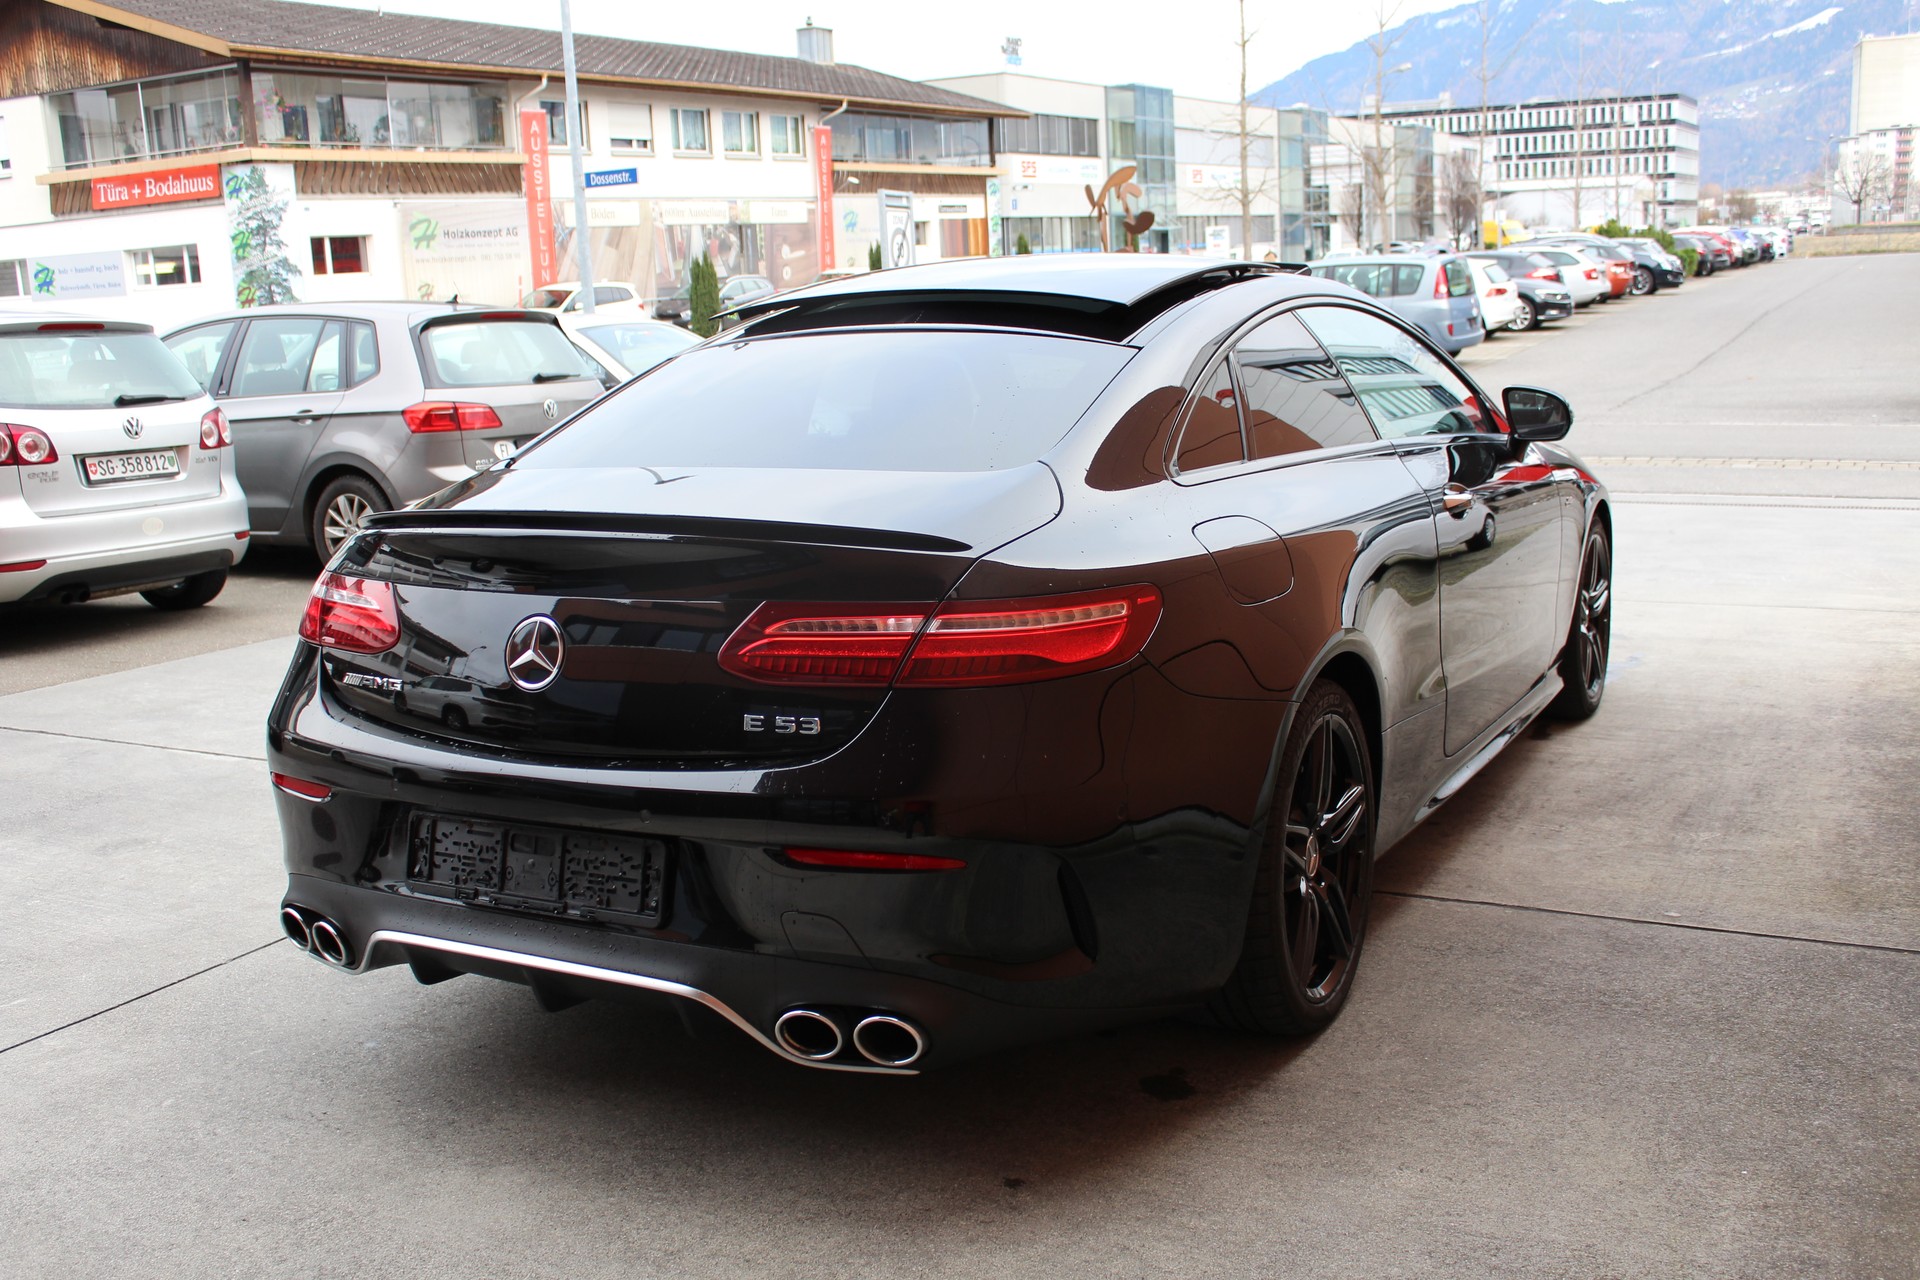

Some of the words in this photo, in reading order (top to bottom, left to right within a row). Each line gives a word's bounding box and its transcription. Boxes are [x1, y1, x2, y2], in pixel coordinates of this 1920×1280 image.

[590, 171, 632, 186] Dossenstr.
[97, 182, 128, 203] Türa
[132, 184, 141, 199] +
[145, 174, 213, 198] Bodahuus
[530, 119, 550, 283] AUSSTELLUN
[820, 134, 831, 269] AUSSTELLUN
[591, 207, 616, 220] Böden
[688, 207, 727, 219] Ausstellung
[443, 226, 503, 240] Holzkonzept
[505, 227, 518, 237] AG
[27, 470, 58, 480] GOLF
[358, 675, 403, 691] AMG
[743, 714, 764, 731] E
[775, 715, 820, 735] 53
